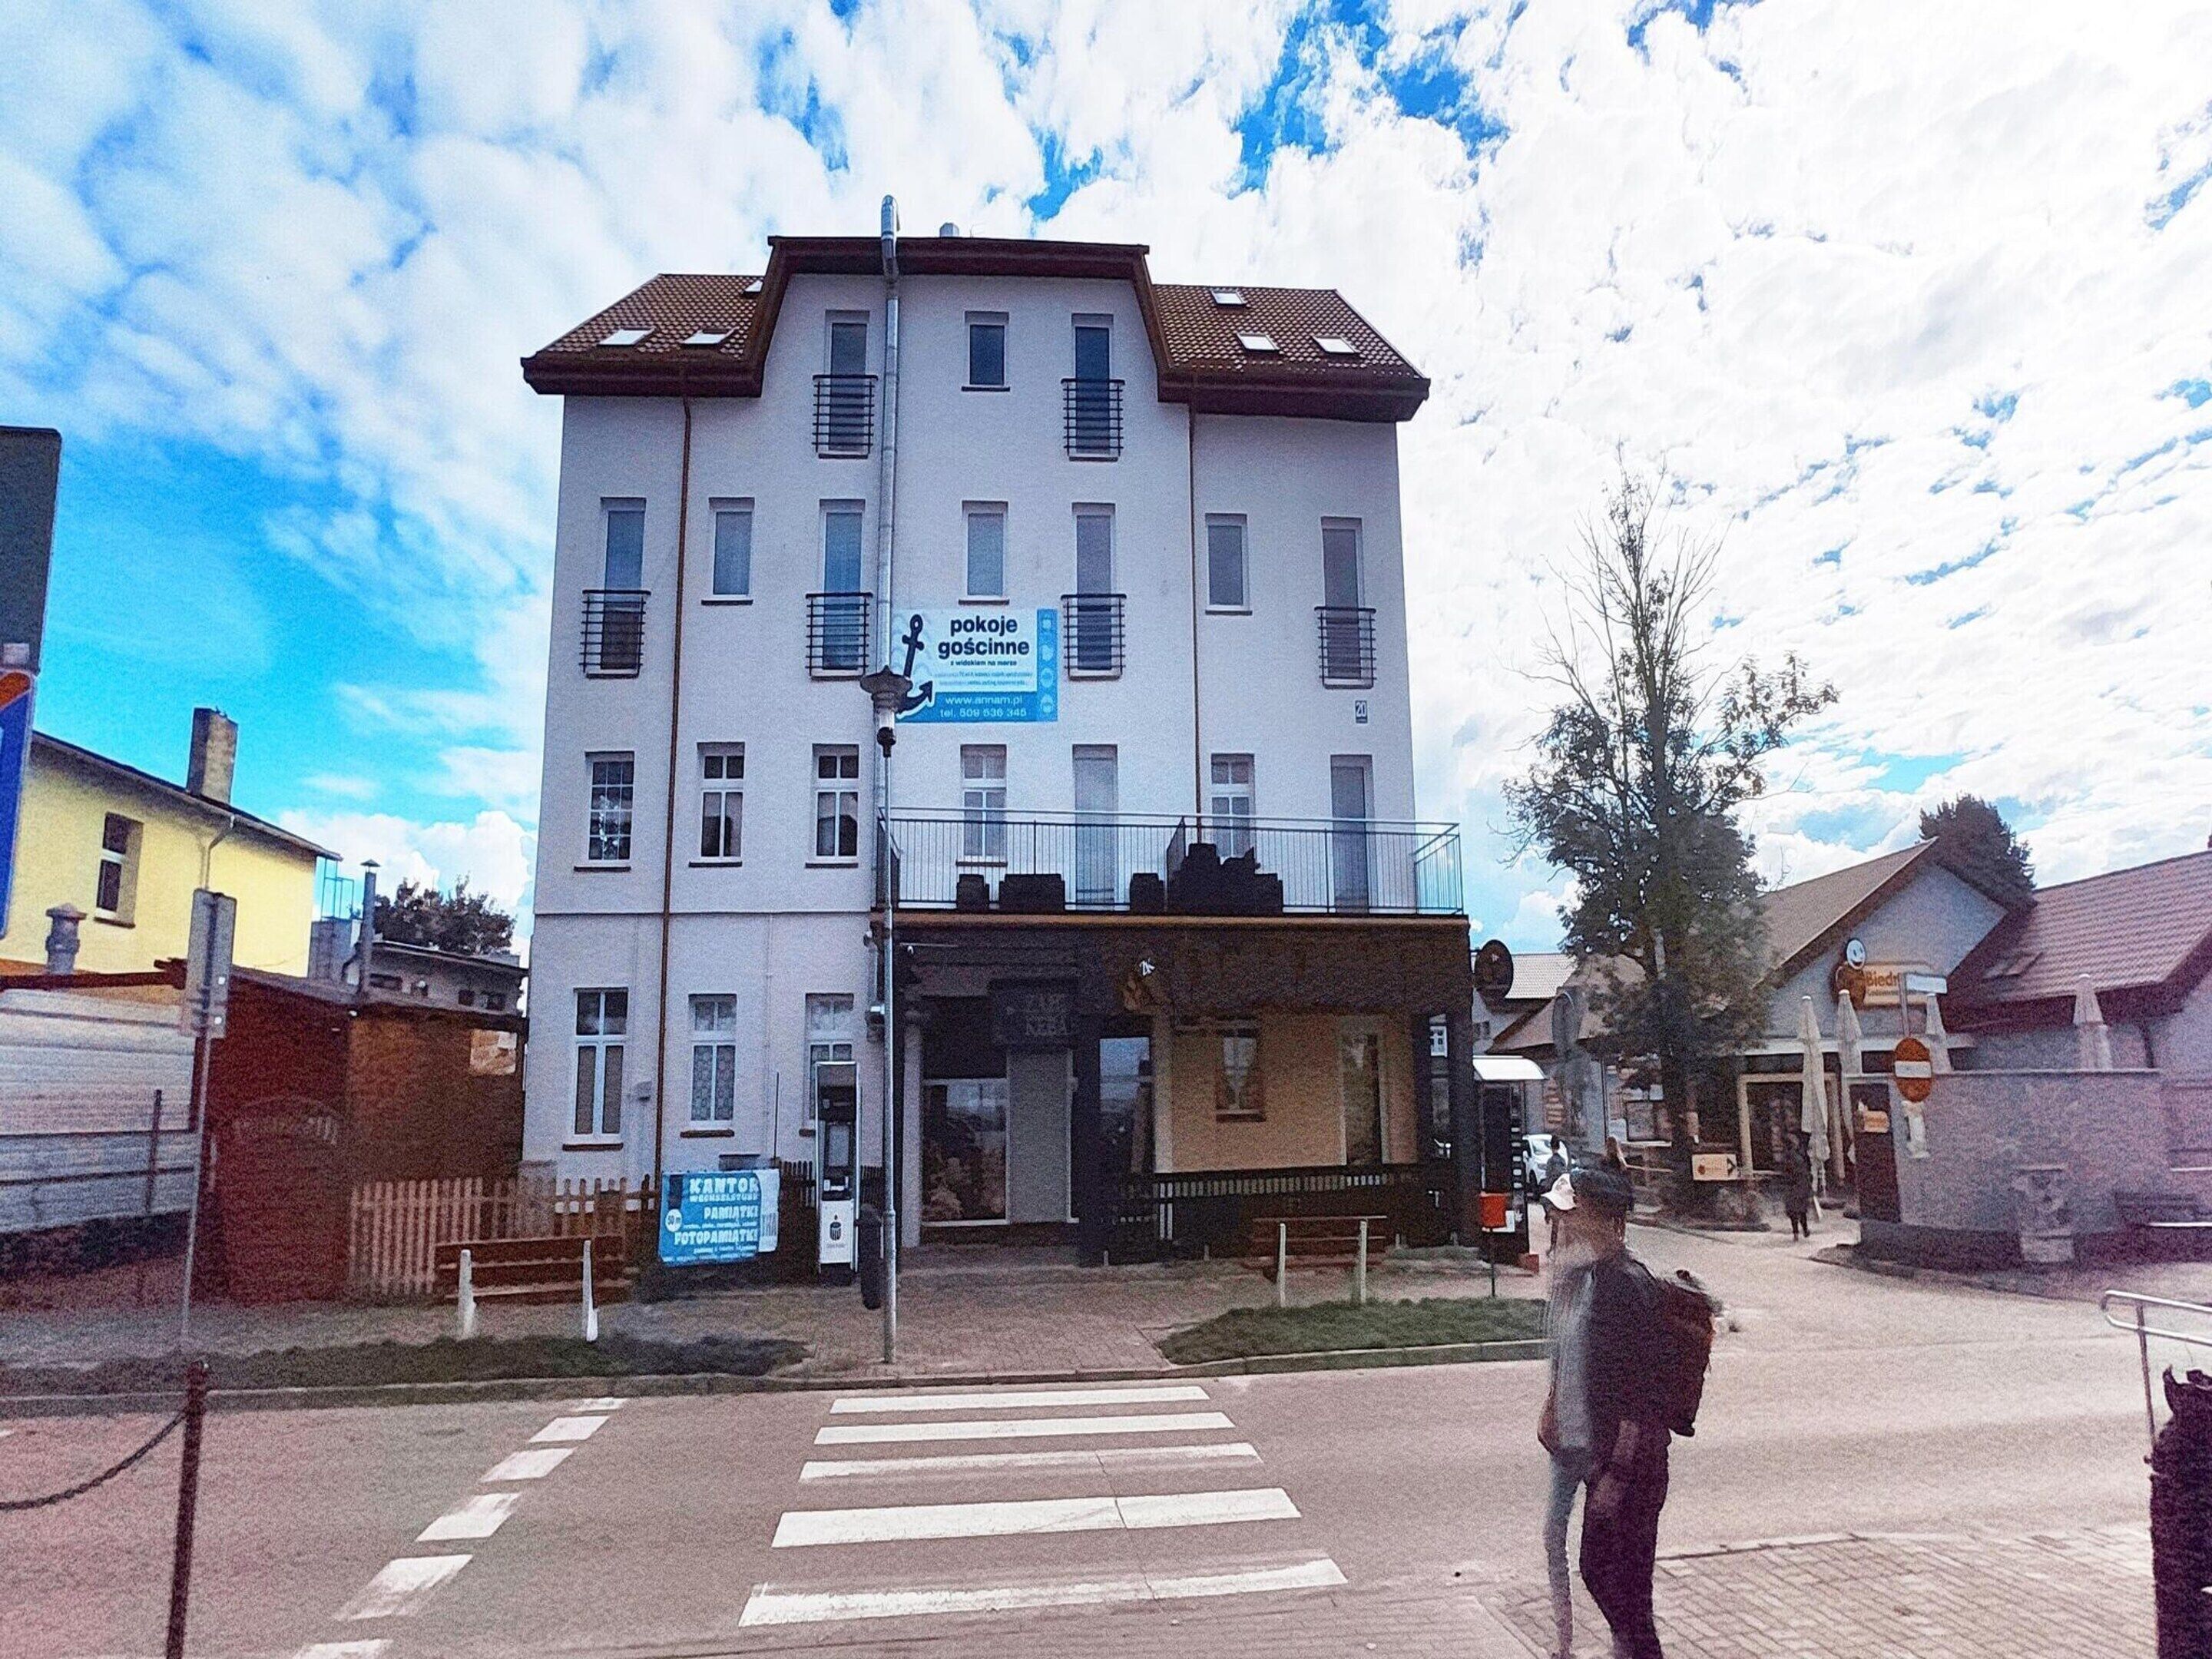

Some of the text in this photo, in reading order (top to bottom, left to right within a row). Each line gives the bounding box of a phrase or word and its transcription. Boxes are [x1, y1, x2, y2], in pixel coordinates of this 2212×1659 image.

[950, 616, 1018, 636] pokoje
[938, 637, 1029, 659] gościnne
[945, 696, 1022, 707] www.annam.pl
[940, 708, 955, 717] tel.
[1356, 702, 1366, 717] 20
[1866, 971, 1898, 986] Biedr
[690, 1177, 759, 1194] KANTOR
